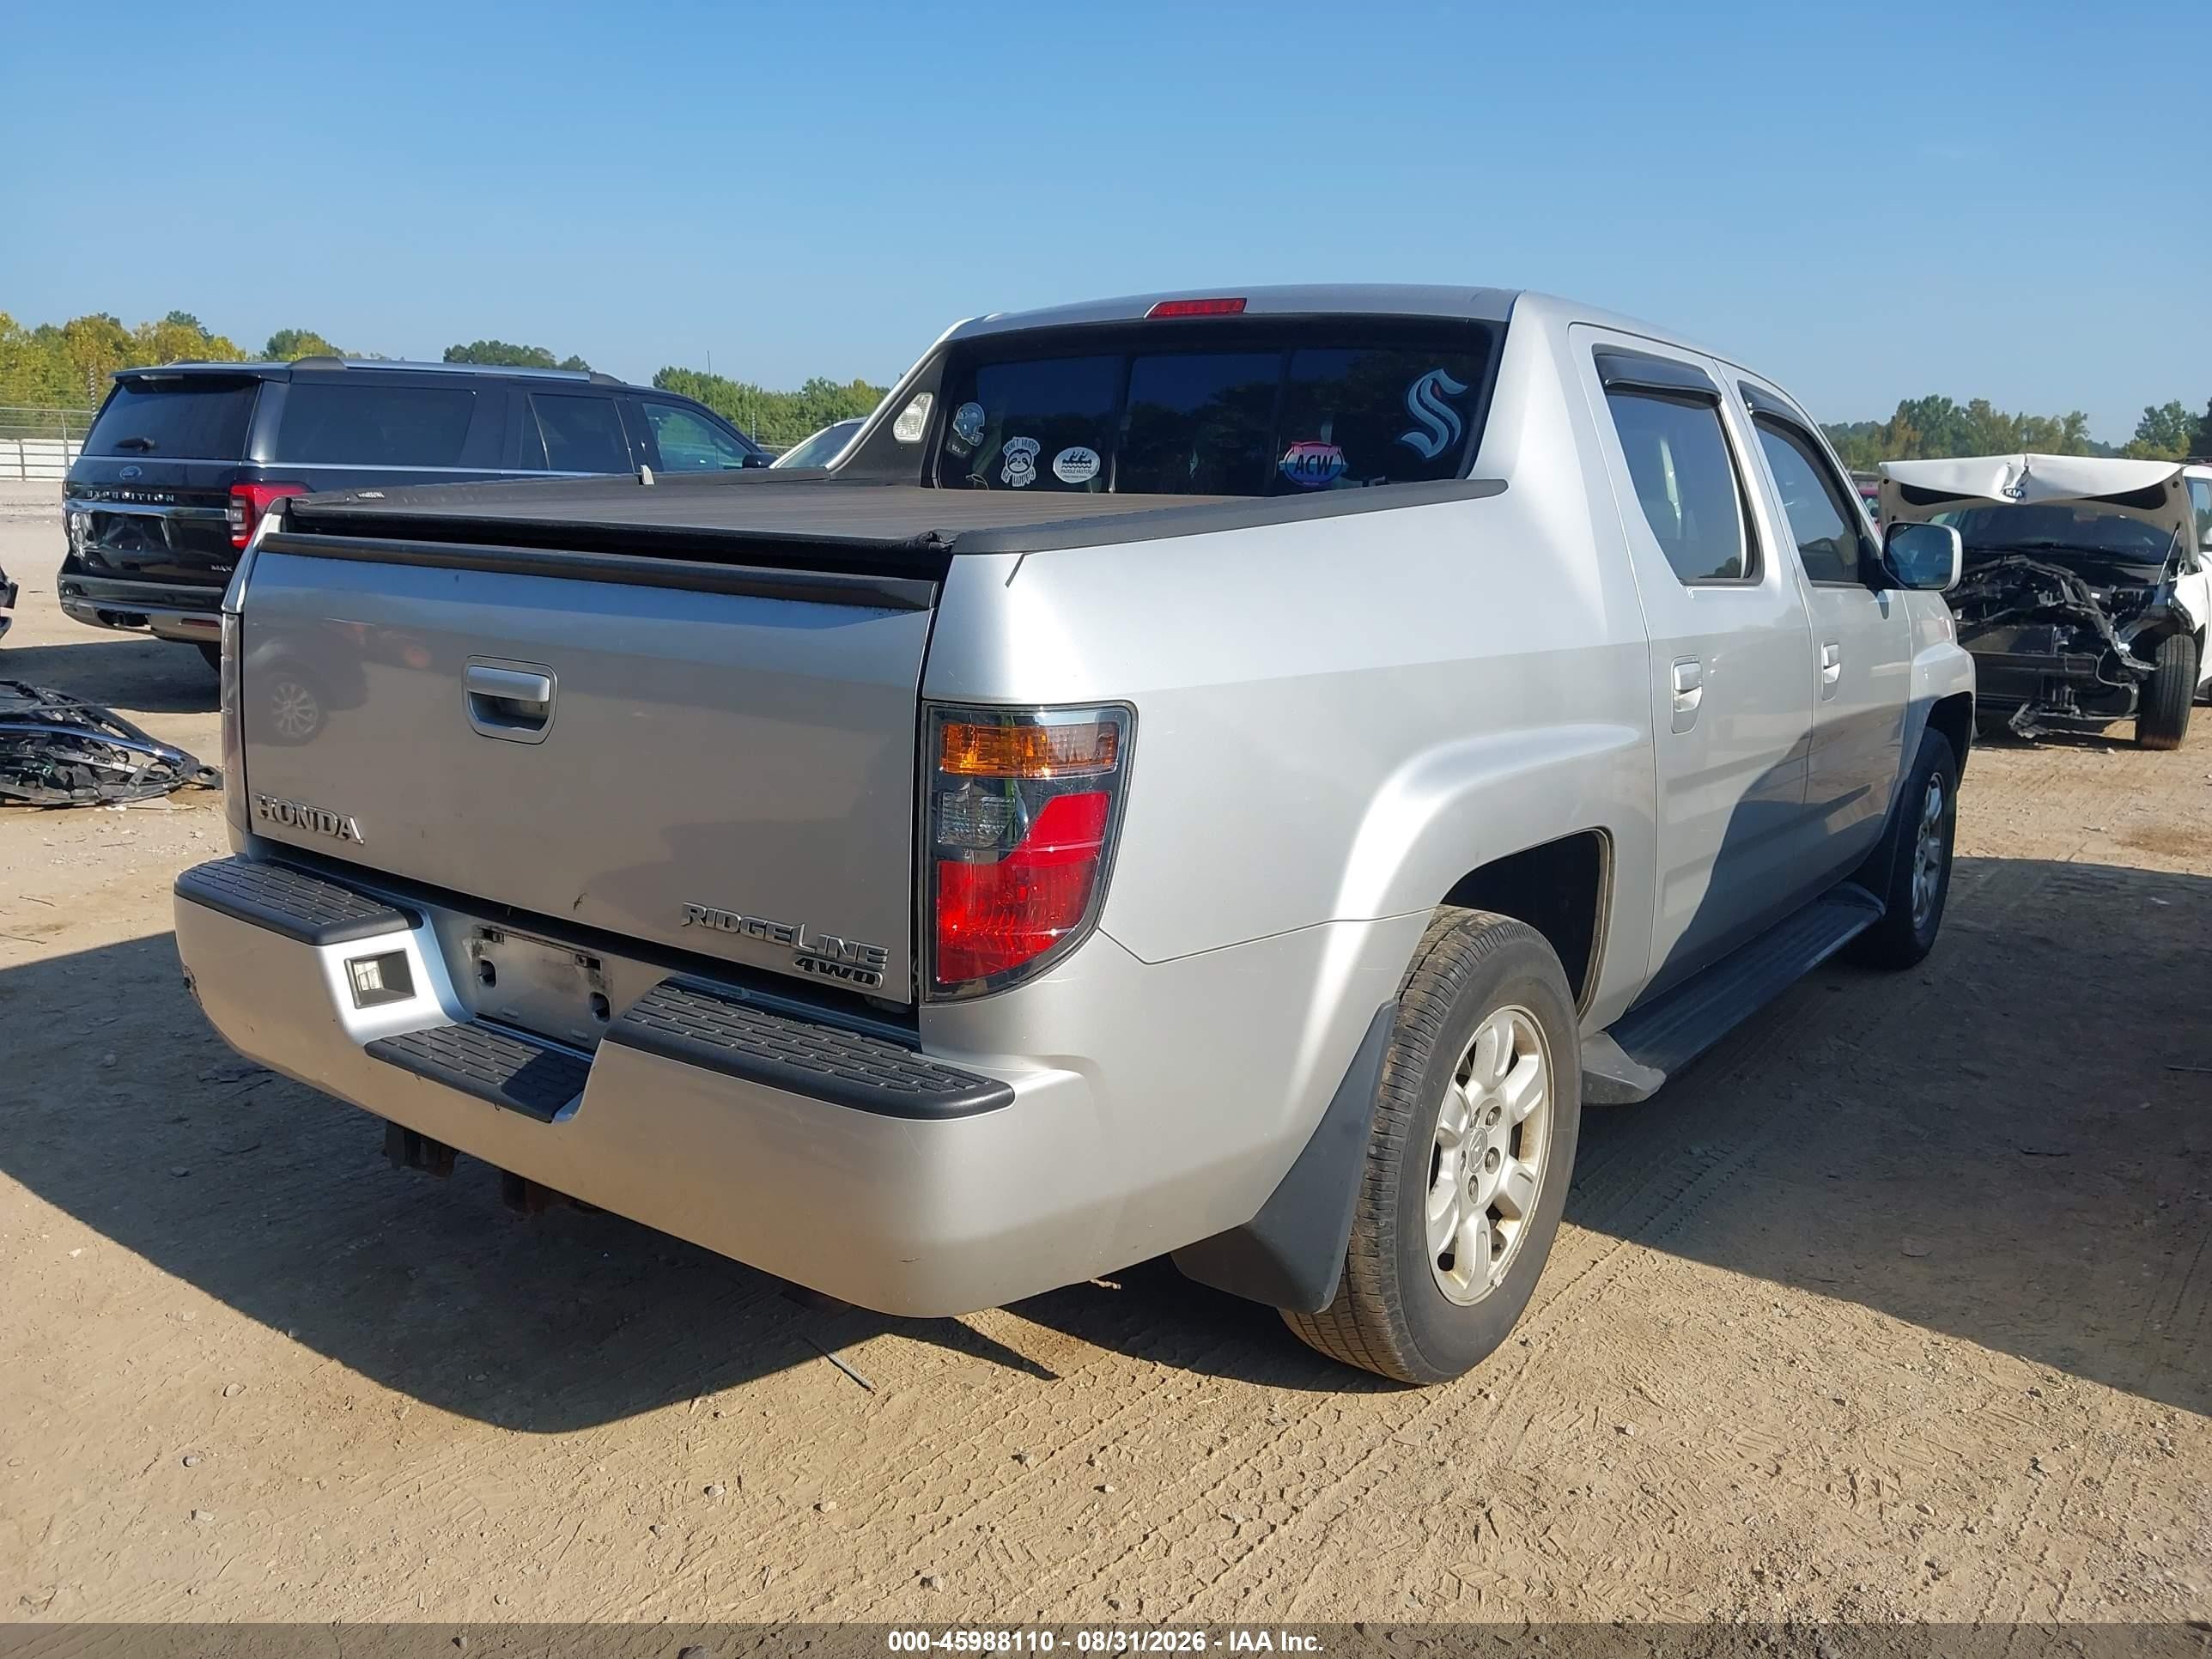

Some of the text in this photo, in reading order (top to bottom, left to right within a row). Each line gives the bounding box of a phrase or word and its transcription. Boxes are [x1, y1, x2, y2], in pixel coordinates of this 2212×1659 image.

[1293, 454, 1334, 475] ACW
[87, 490, 174, 502] EXPEDITION
[2005, 489, 2023, 498] KIA
[254, 793, 364, 844] HONDA
[681, 901, 890, 970] RIDGELINE
[793, 955, 884, 990] 4WD
